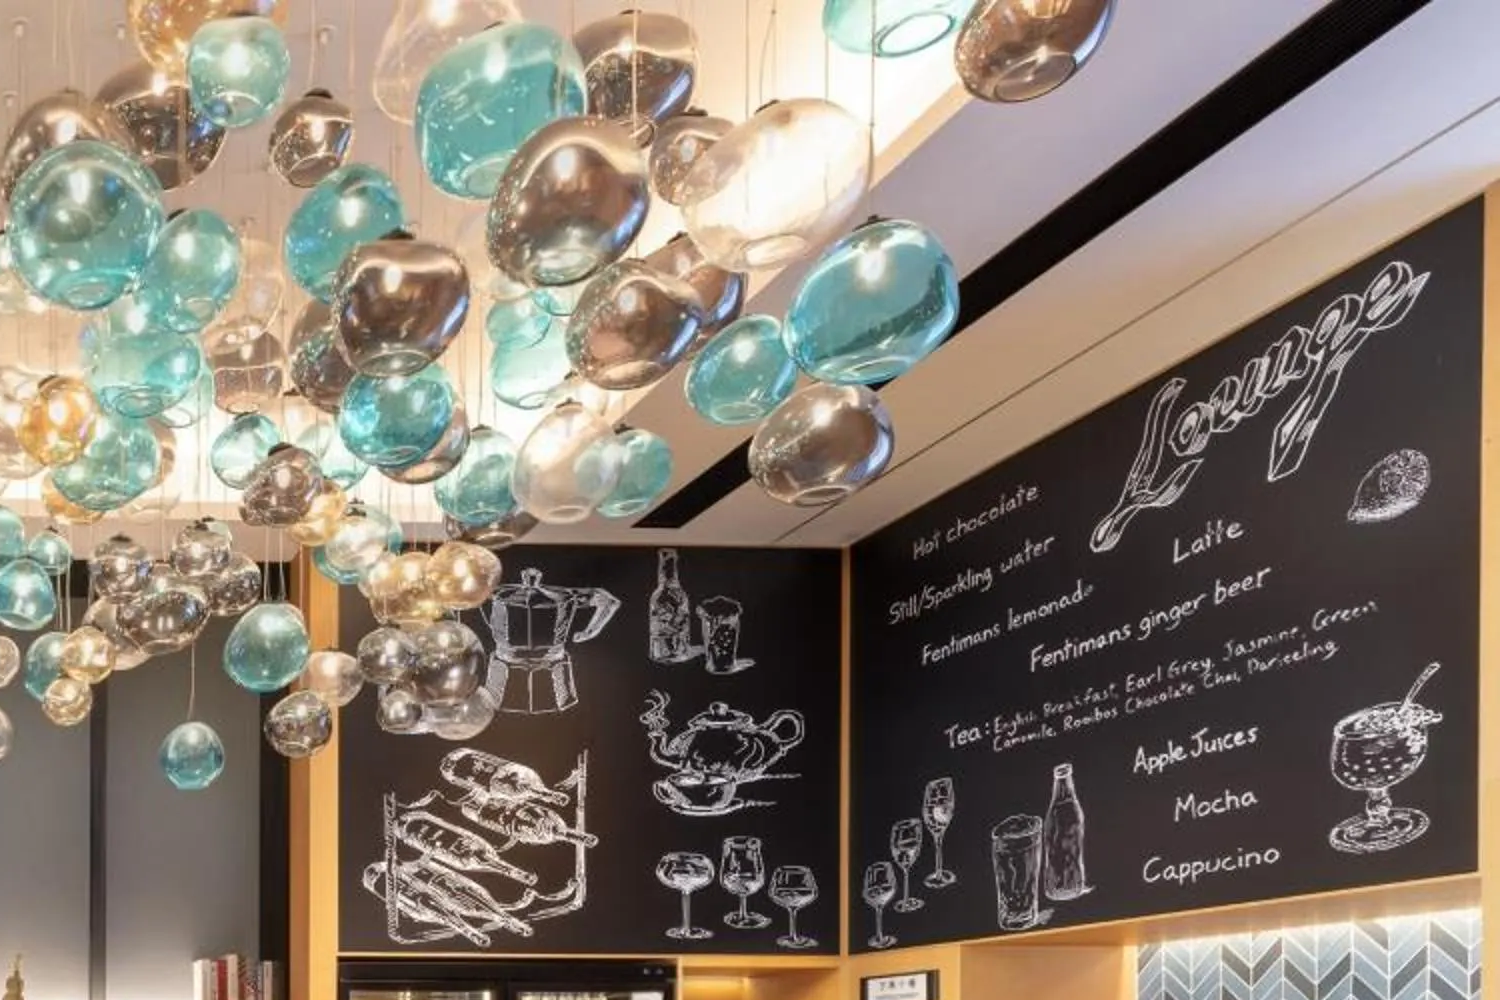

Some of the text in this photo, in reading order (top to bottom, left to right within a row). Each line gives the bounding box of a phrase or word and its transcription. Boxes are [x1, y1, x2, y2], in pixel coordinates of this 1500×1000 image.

[1090, 261, 1431, 553] Lounge
[912, 485, 1039, 560] Hot chocolate
[1173, 519, 1245, 564] Latte
[889, 536, 1055, 625] Still/Sparkling water
[1030, 566, 1272, 673] Fentimans ginger beer
[921, 623, 1000, 666] Fentimans
[944, 722, 990, 749] Tea:
[1125, 664, 1162, 693] Earl
[1311, 600, 1379, 631] Green
[1125, 682, 1196, 713] Chocolate
[1133, 727, 1260, 775] Apple Juices
[1173, 789, 1259, 822] Mocha
[1143, 848, 1281, 886] Cappucino
